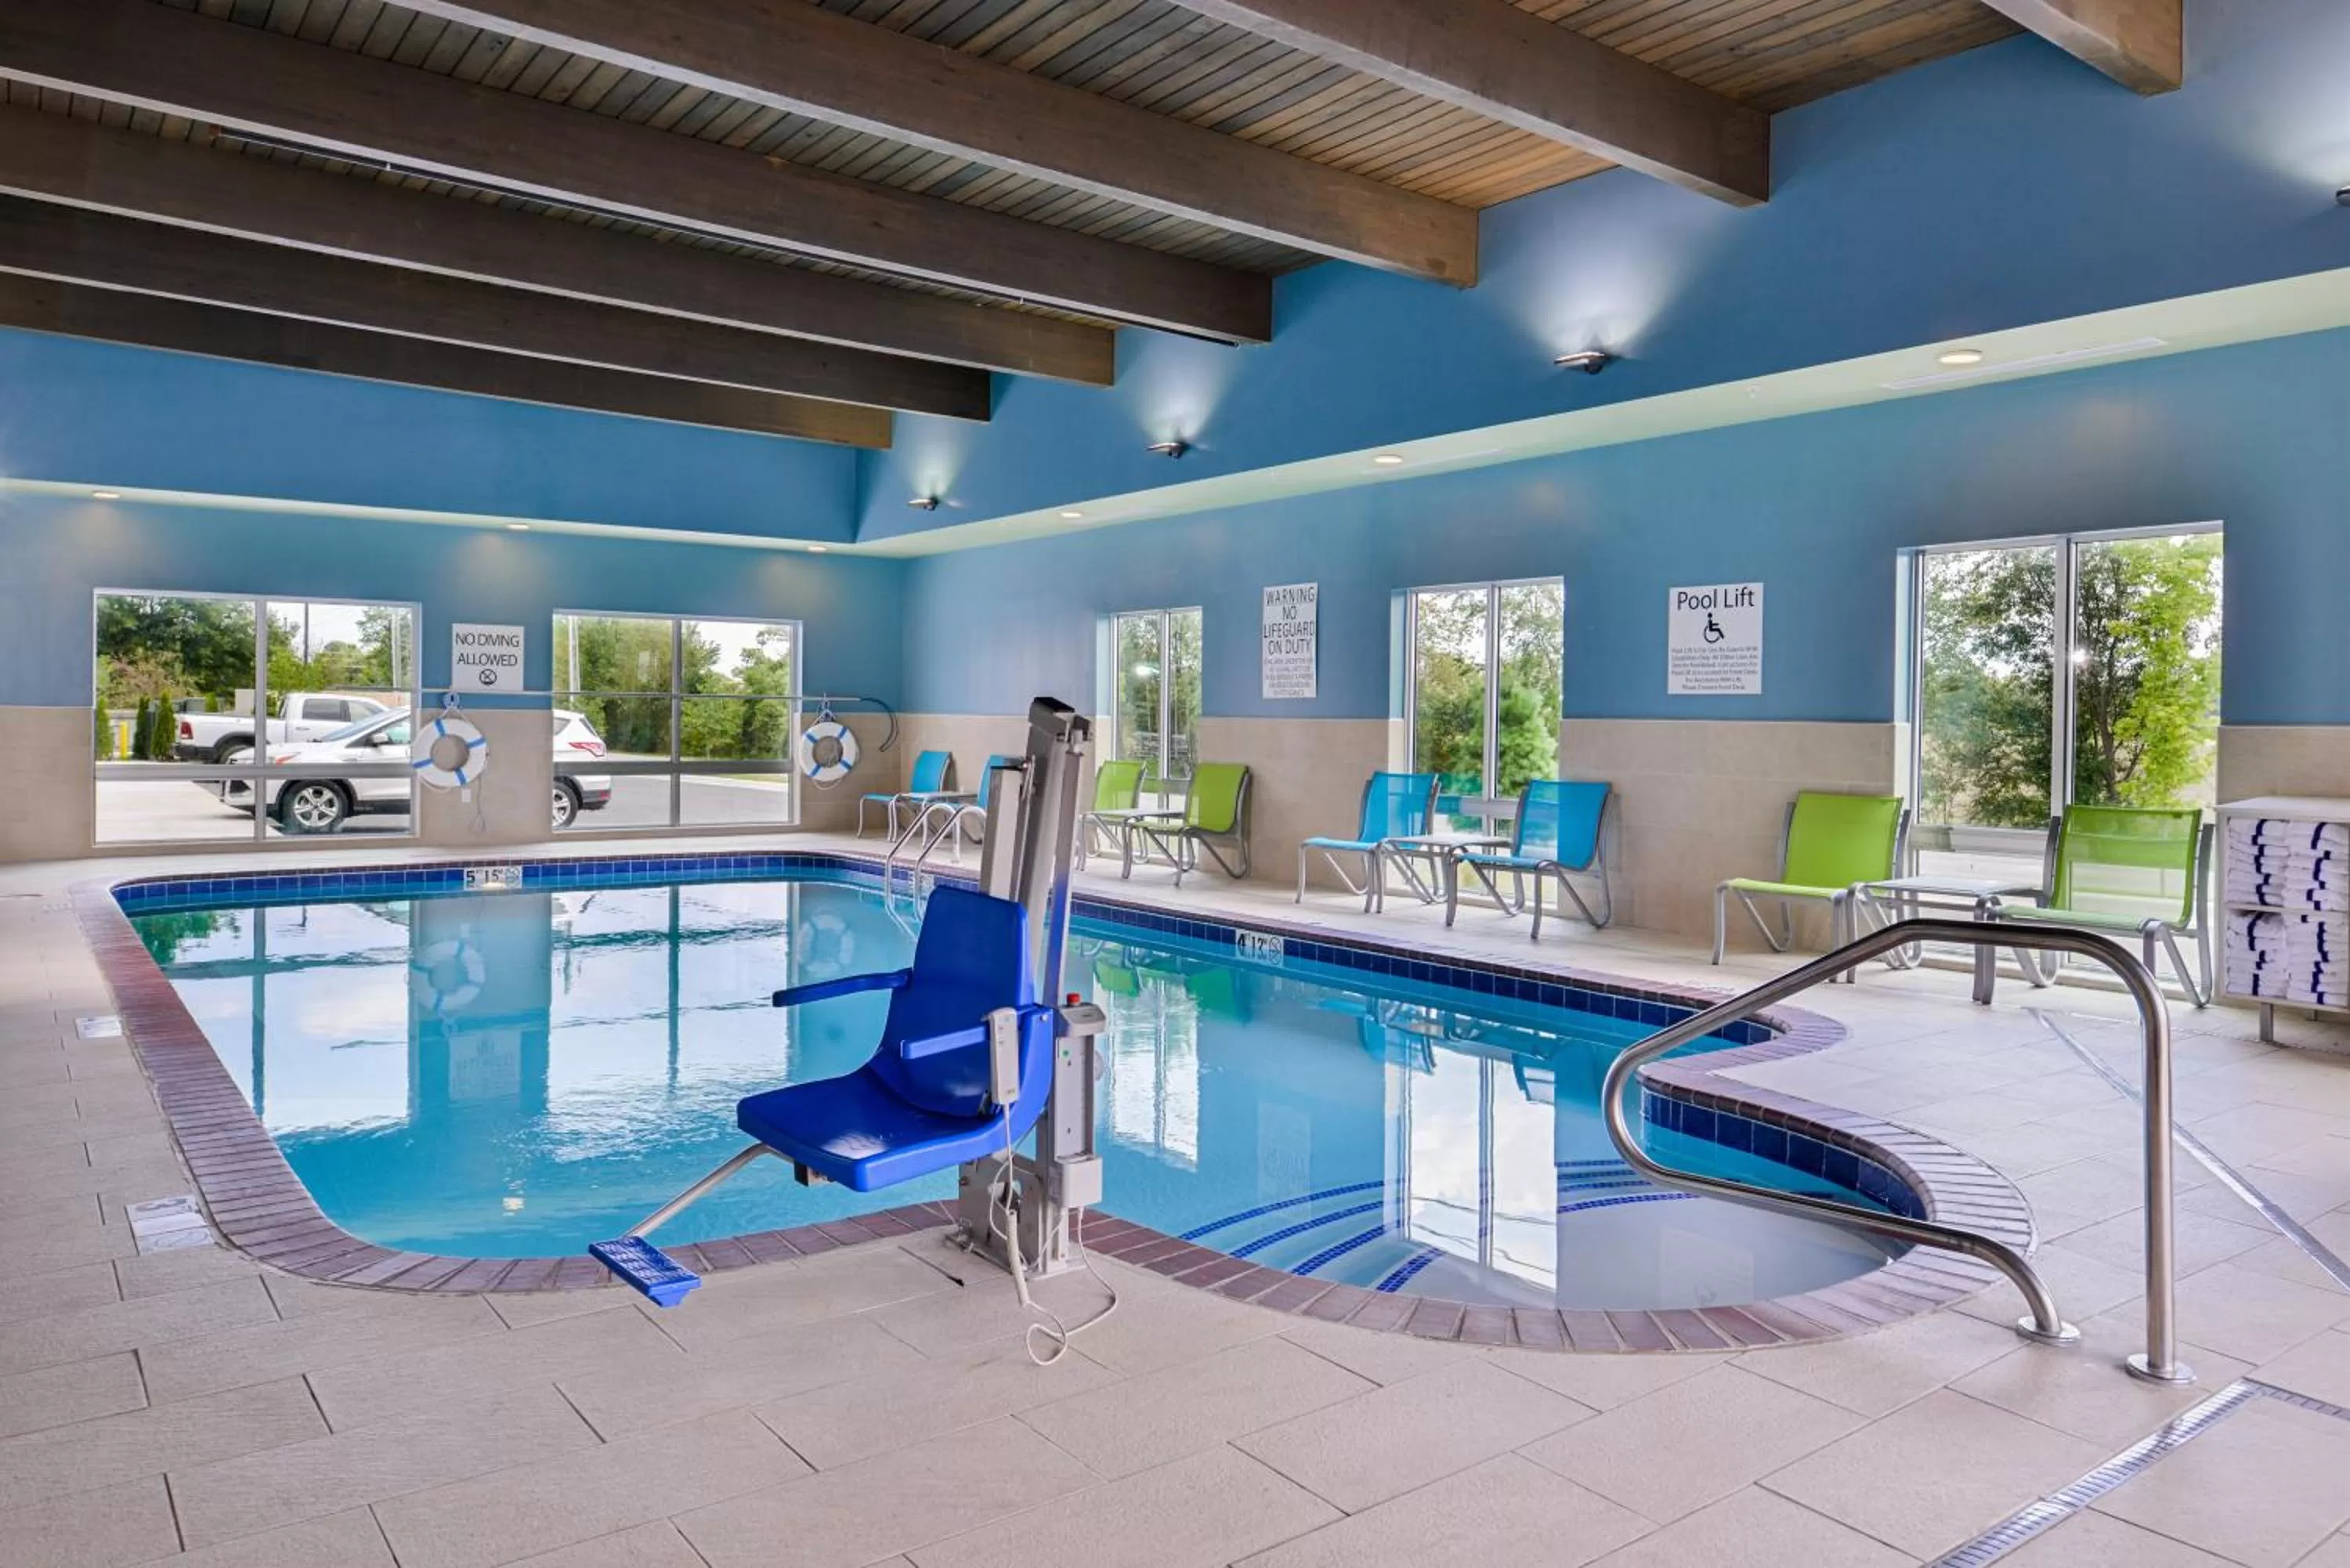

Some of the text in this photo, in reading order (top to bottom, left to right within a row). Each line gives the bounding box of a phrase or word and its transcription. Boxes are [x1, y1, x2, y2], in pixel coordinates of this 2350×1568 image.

[1266, 587, 1315, 605] WARNING
[1677, 587, 1755, 610] Pool Lift
[1282, 605, 1297, 620] NO
[1264, 620, 1315, 638] LIFEGUARD
[455, 632, 520, 648] NO DIVING
[1267, 638, 1312, 656] ON DUTY
[457, 652, 519, 667] ALLOWED
